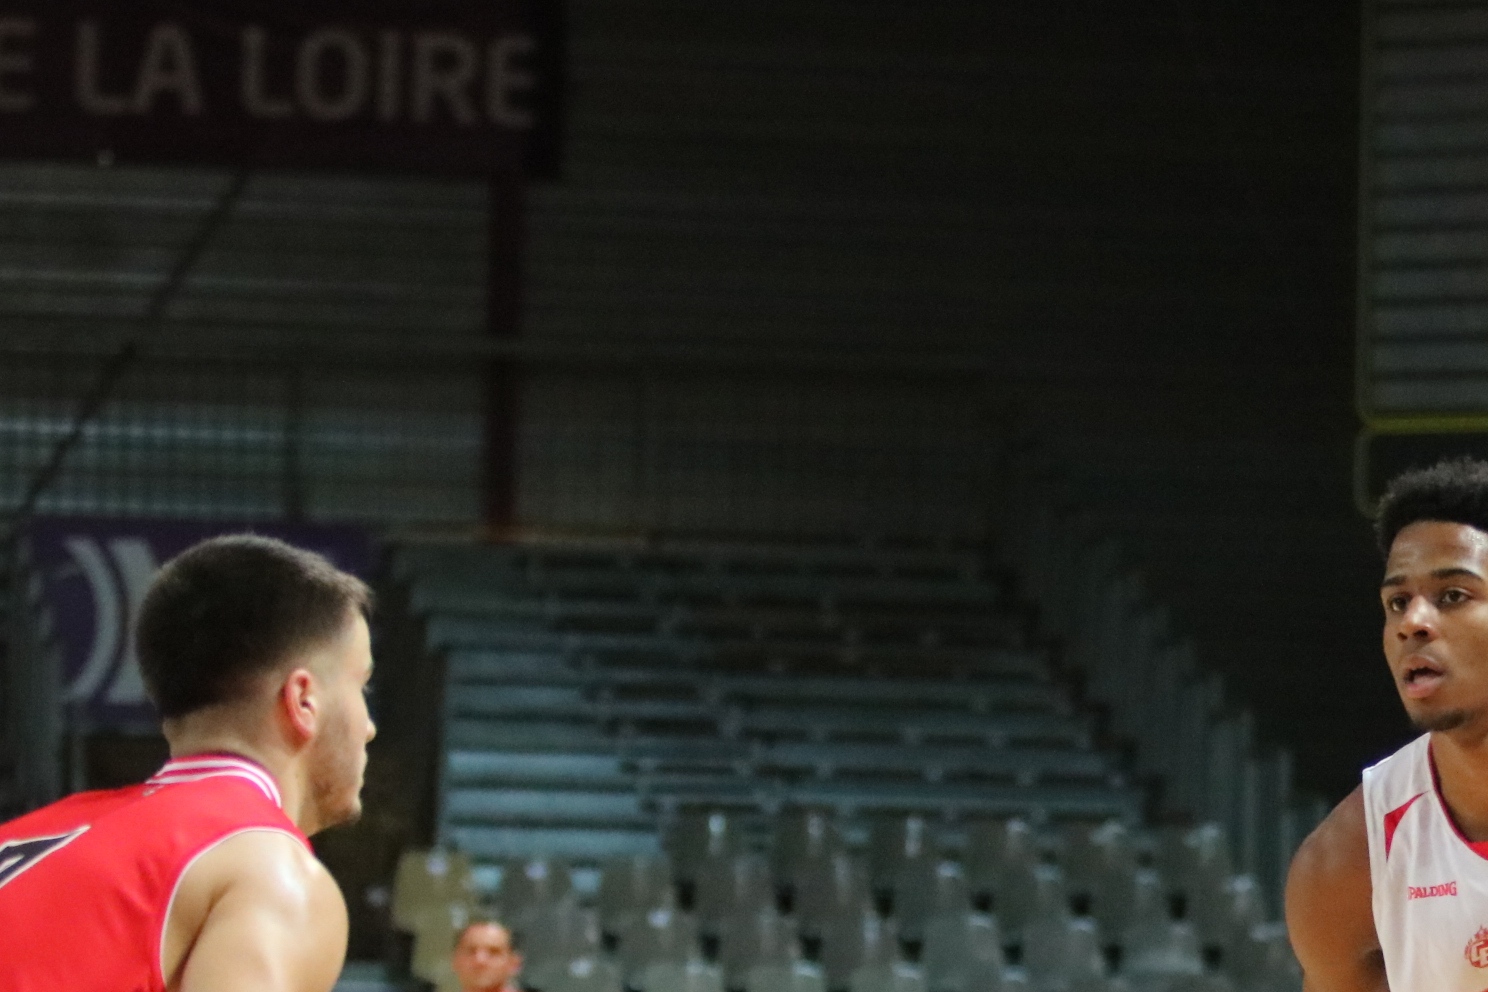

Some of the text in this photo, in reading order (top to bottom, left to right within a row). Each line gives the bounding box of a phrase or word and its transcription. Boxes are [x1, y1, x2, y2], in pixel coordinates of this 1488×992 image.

[76, 20, 203, 115] LA
[241, 25, 537, 129] LOIRE
[1408, 881, 1457, 900] PALDING
